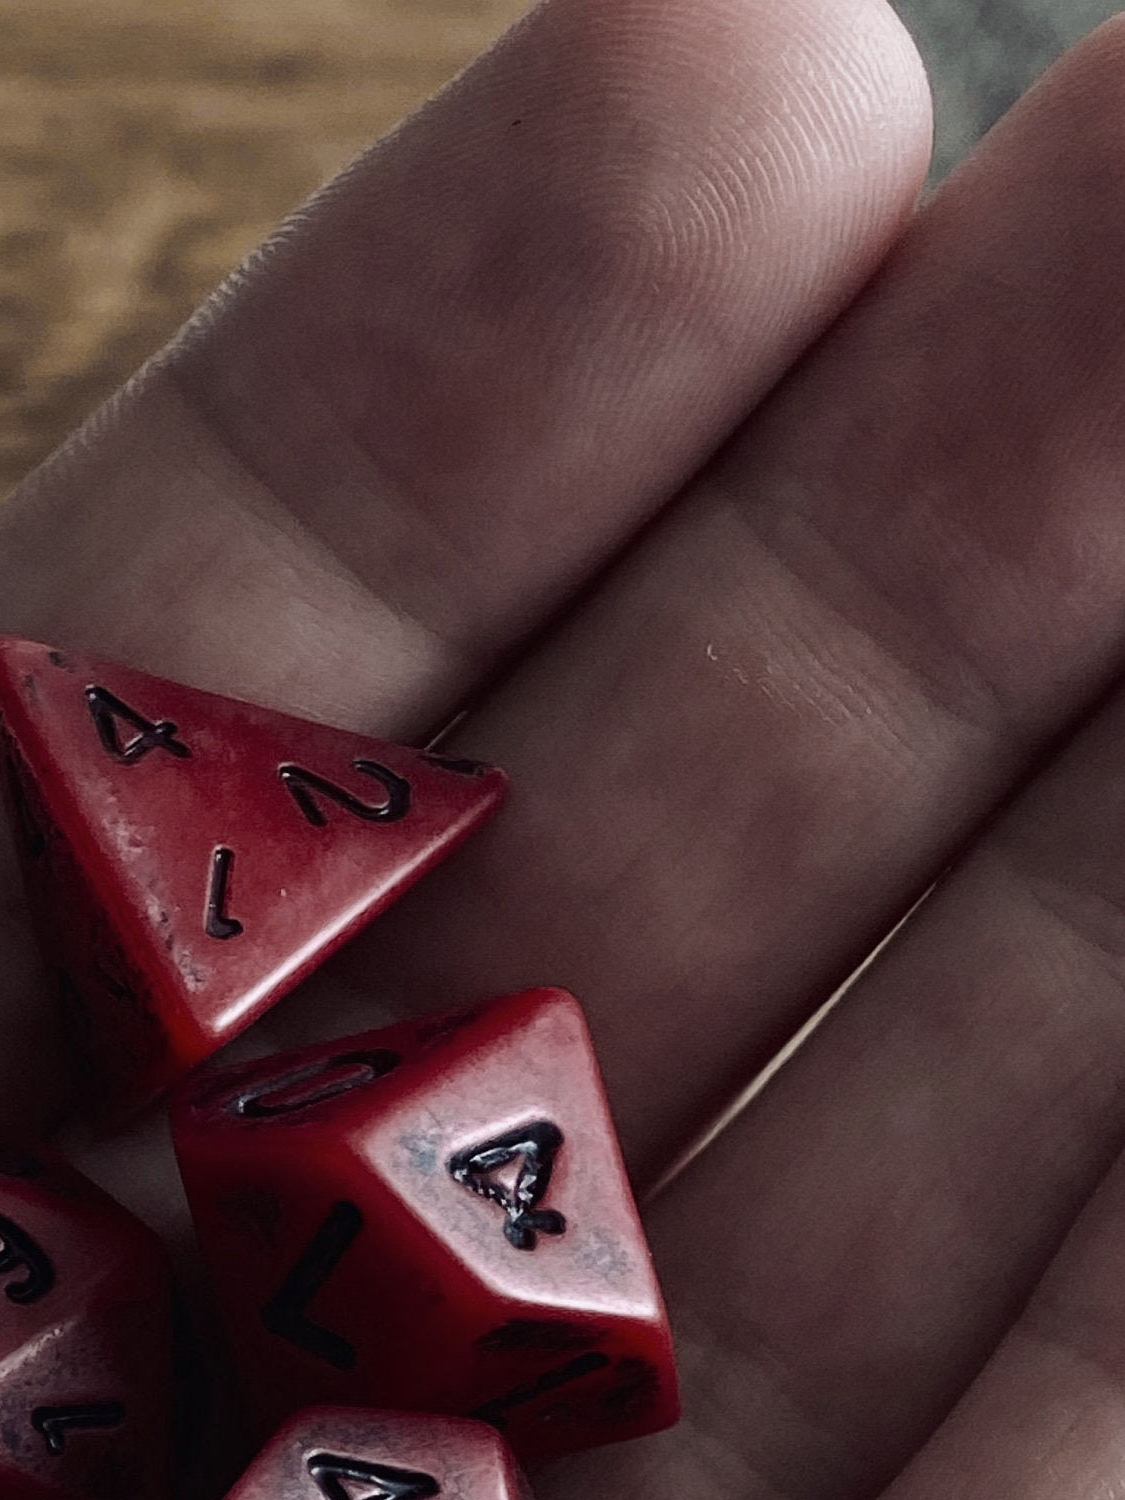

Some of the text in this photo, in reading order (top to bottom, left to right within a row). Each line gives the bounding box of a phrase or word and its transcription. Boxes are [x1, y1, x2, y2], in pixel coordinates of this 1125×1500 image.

[86, 683, 191, 764] 4
[278, 758, 412, 827] 2
[204, 845, 244, 940] 1
[447, 1119, 567, 1250] 4
[260, 1199, 364, 1371] 7
